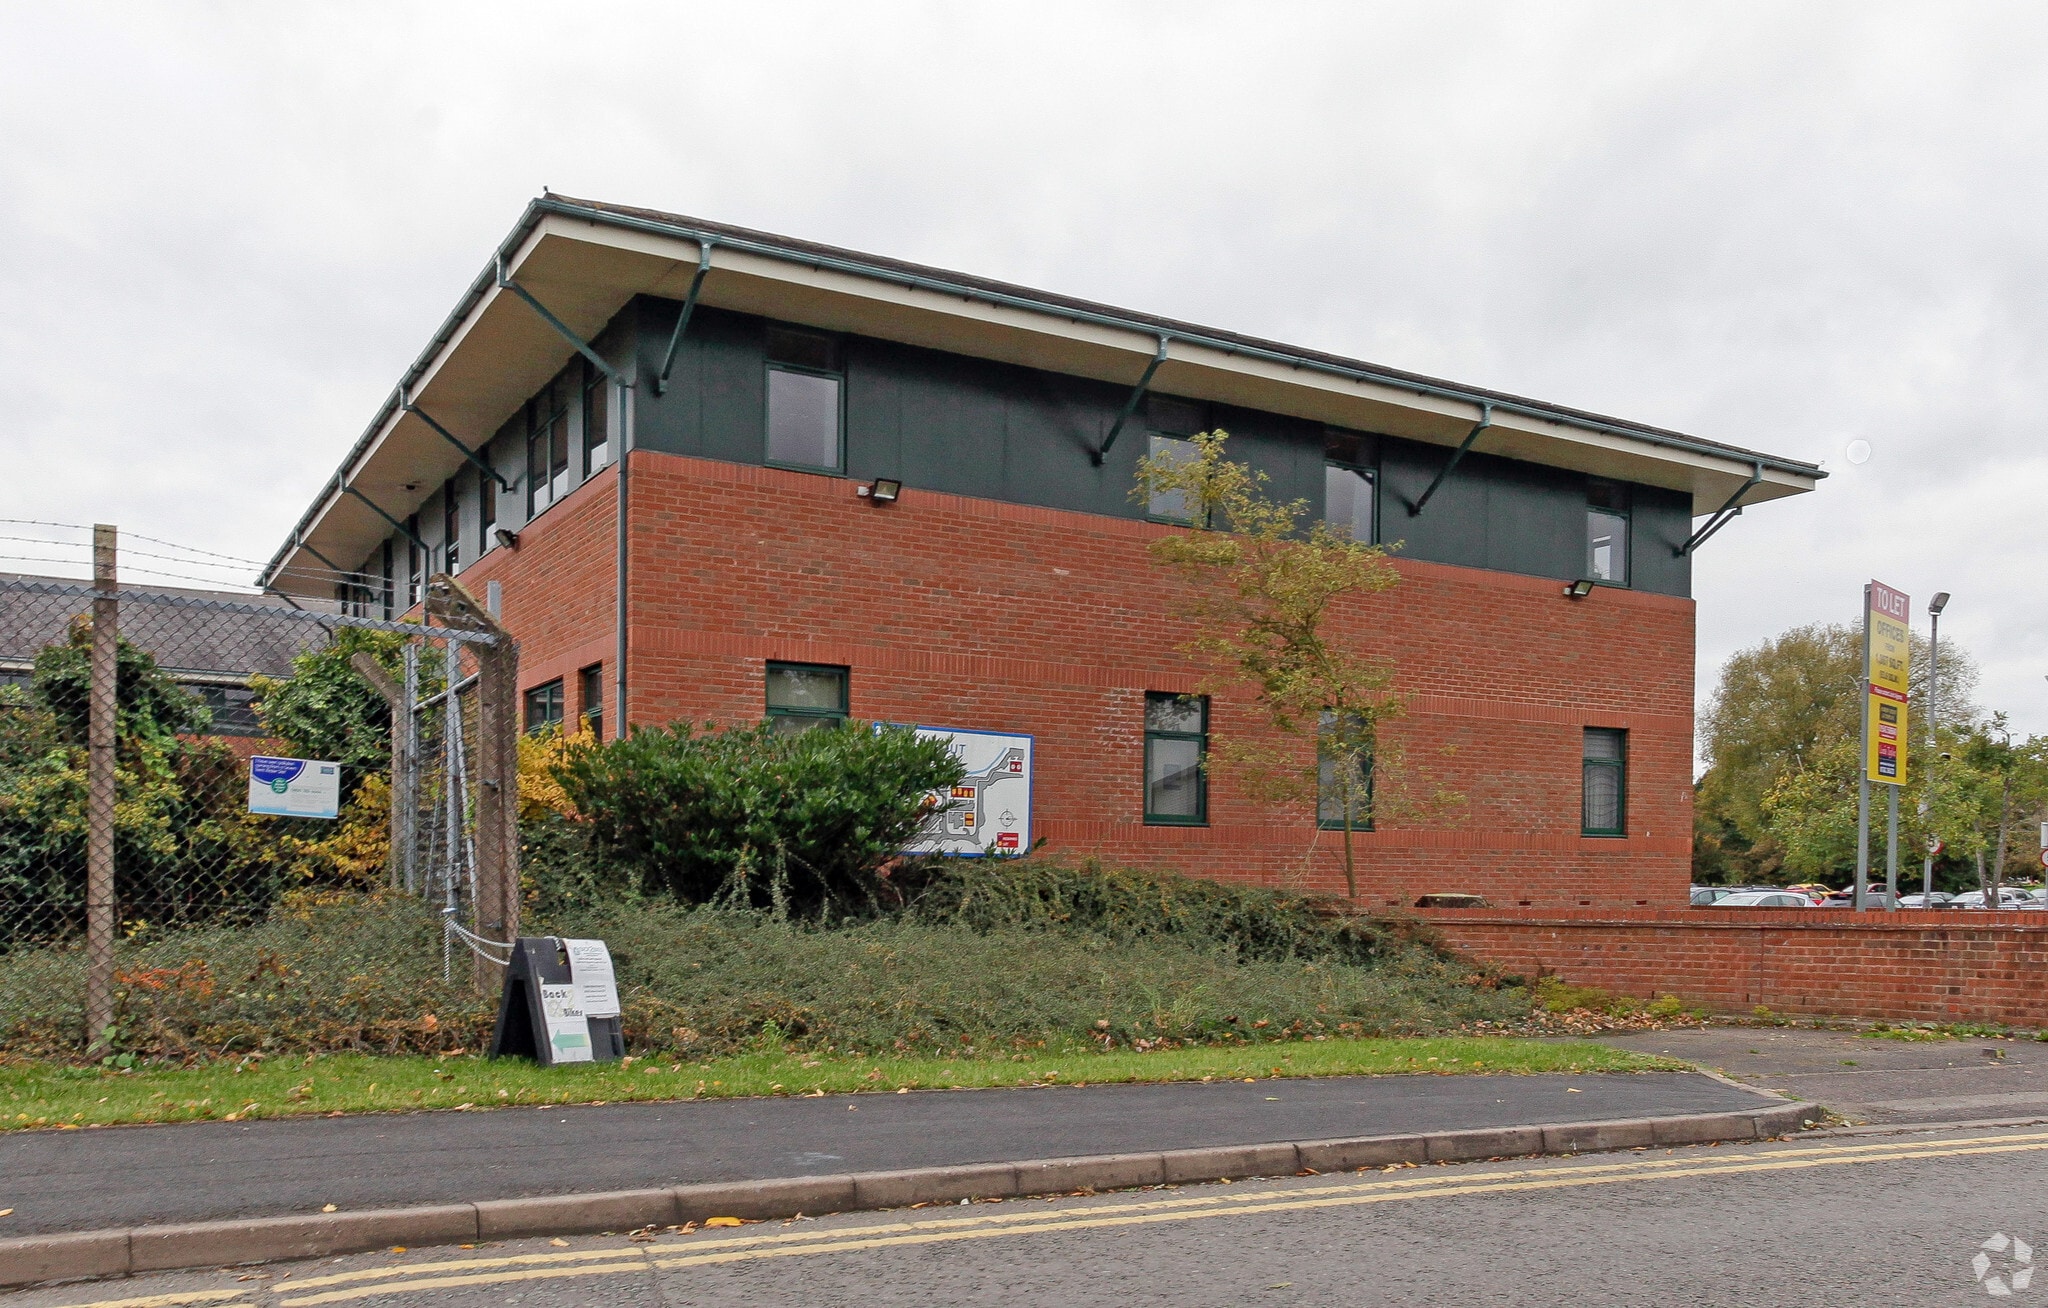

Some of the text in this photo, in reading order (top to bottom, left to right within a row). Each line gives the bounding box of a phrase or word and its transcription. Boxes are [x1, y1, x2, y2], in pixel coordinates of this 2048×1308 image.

[1877, 587, 1905, 617] TO LET
[543, 989, 567, 998] Back
